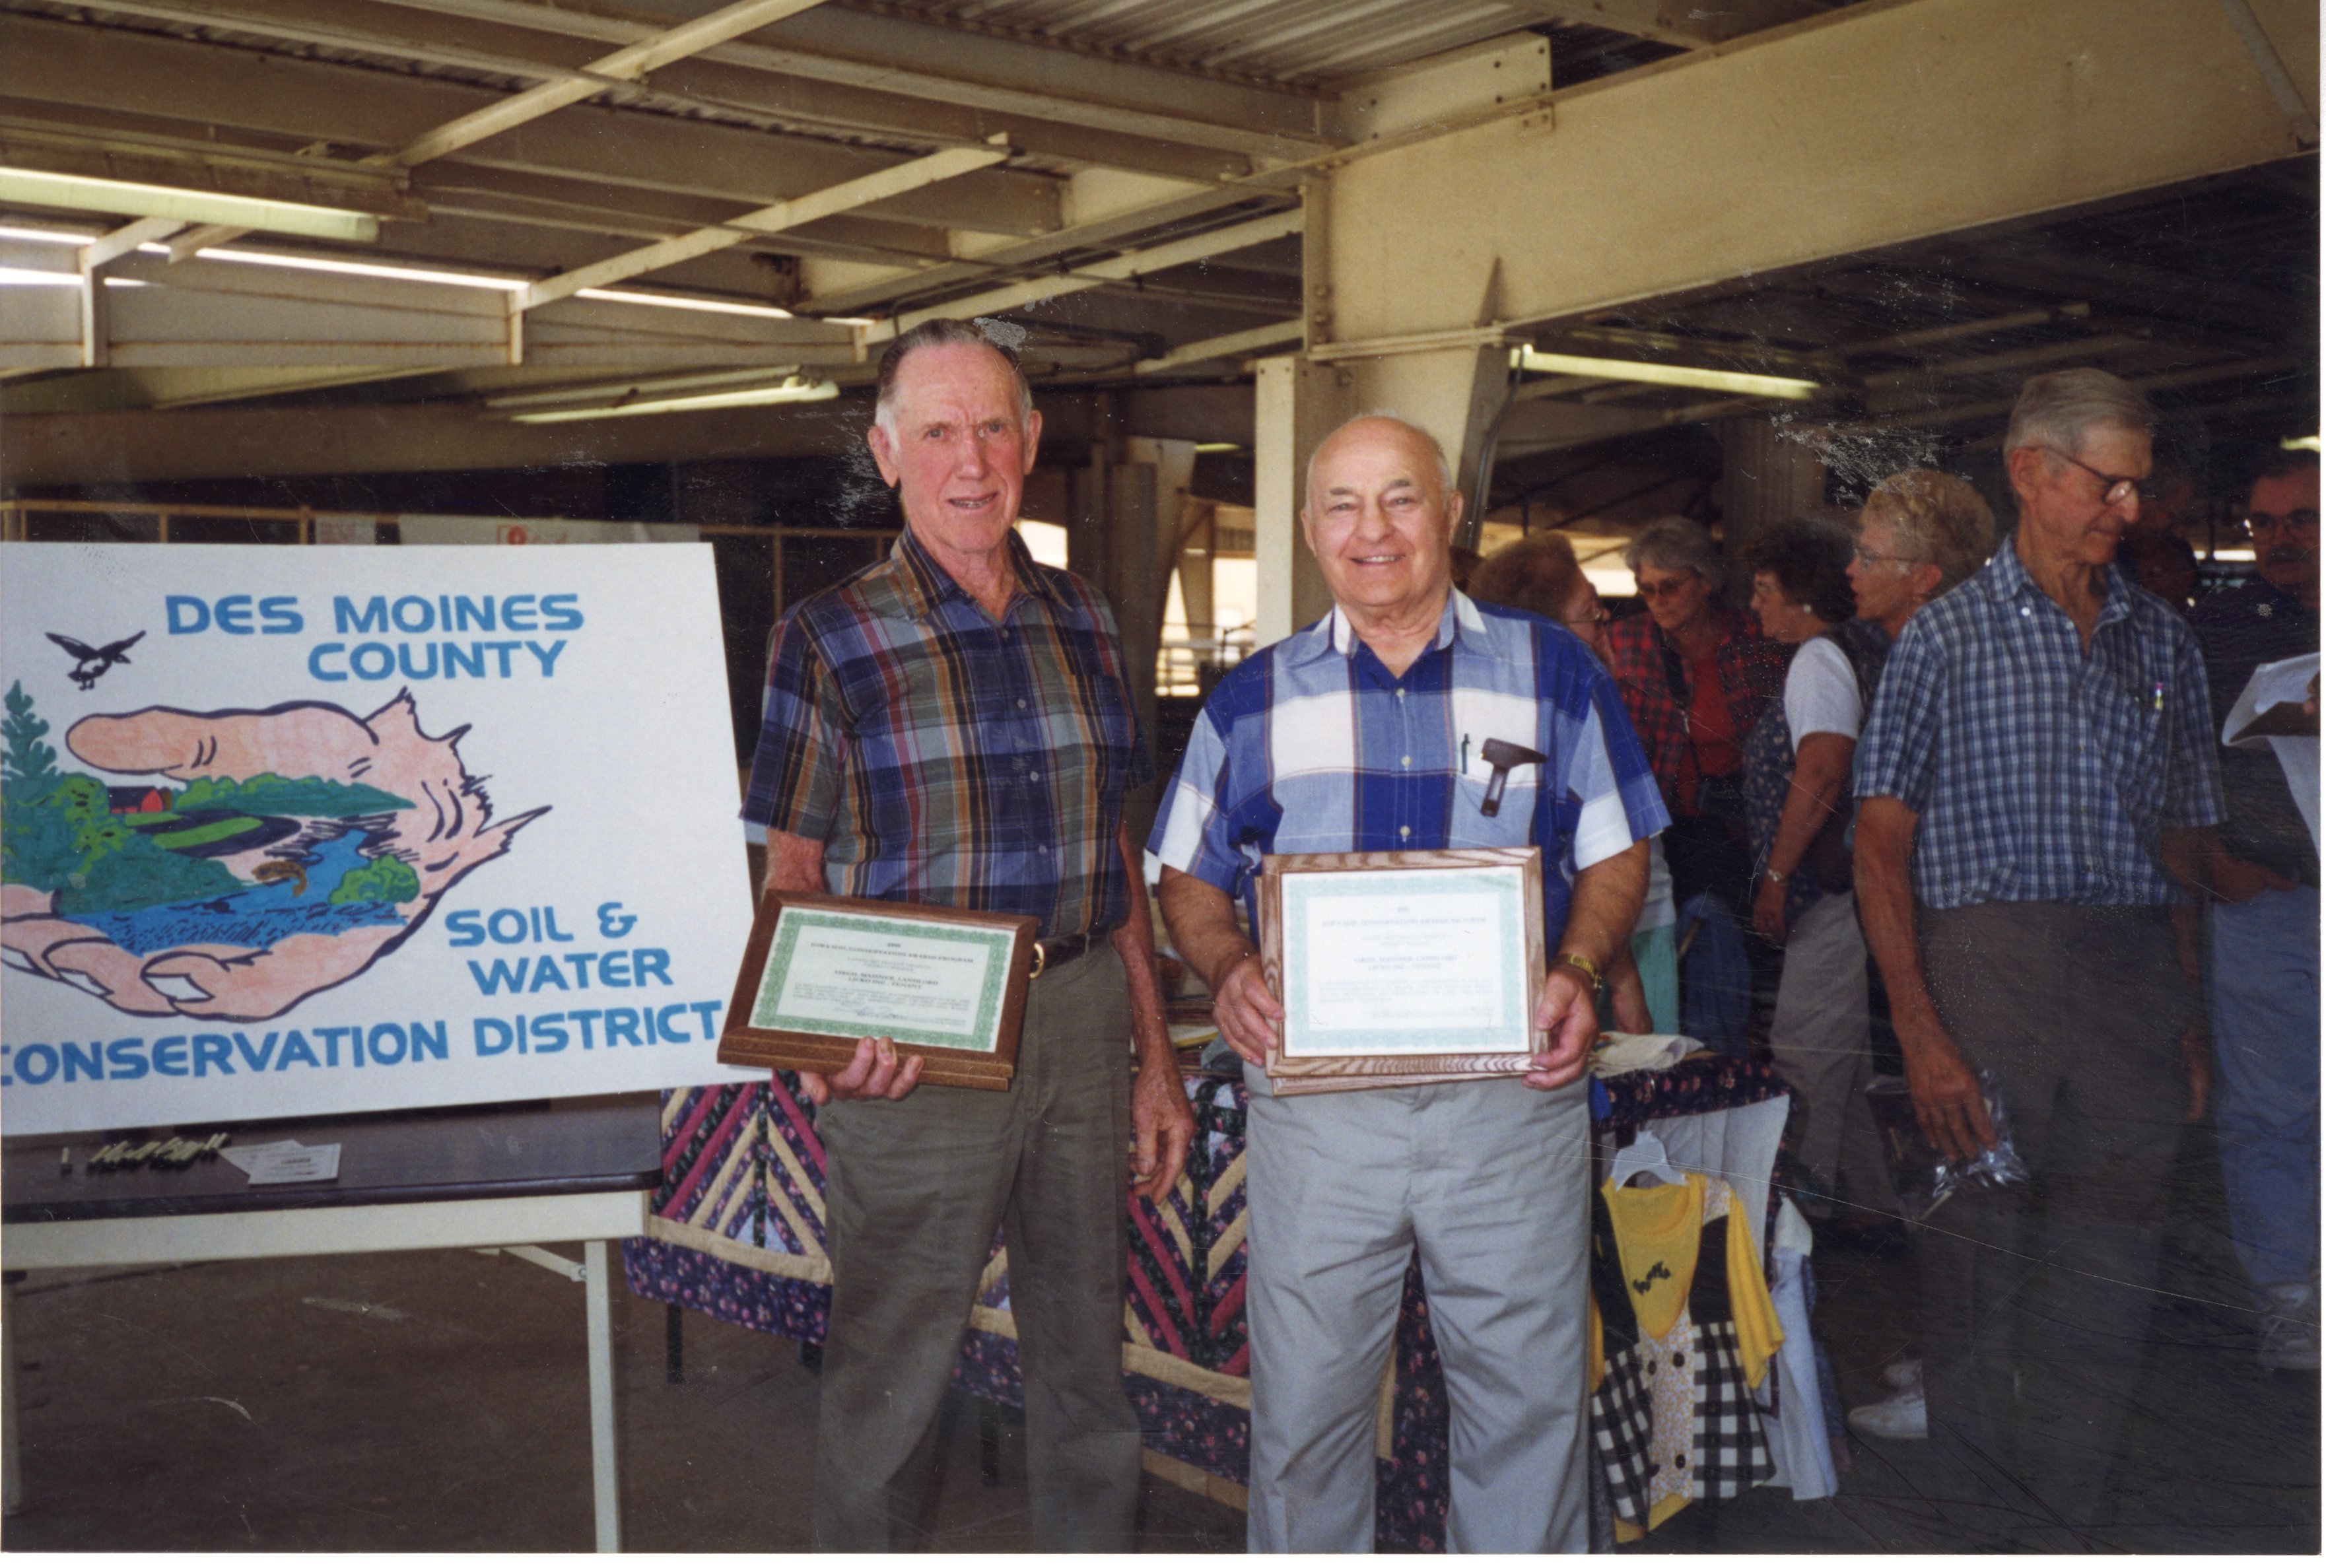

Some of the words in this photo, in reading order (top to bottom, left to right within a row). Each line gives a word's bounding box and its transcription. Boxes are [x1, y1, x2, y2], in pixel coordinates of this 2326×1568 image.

[166, 595, 304, 635] DES
[333, 594, 584, 634] MOINES
[308, 640, 566, 682] COUNTY
[444, 906, 574, 947] SOIL
[598, 901, 638, 939] &
[467, 947, 673, 996] WATER
[848, 946, 906, 956] CONSERVATION
[473, 1000, 722, 1057] DISTRICT
